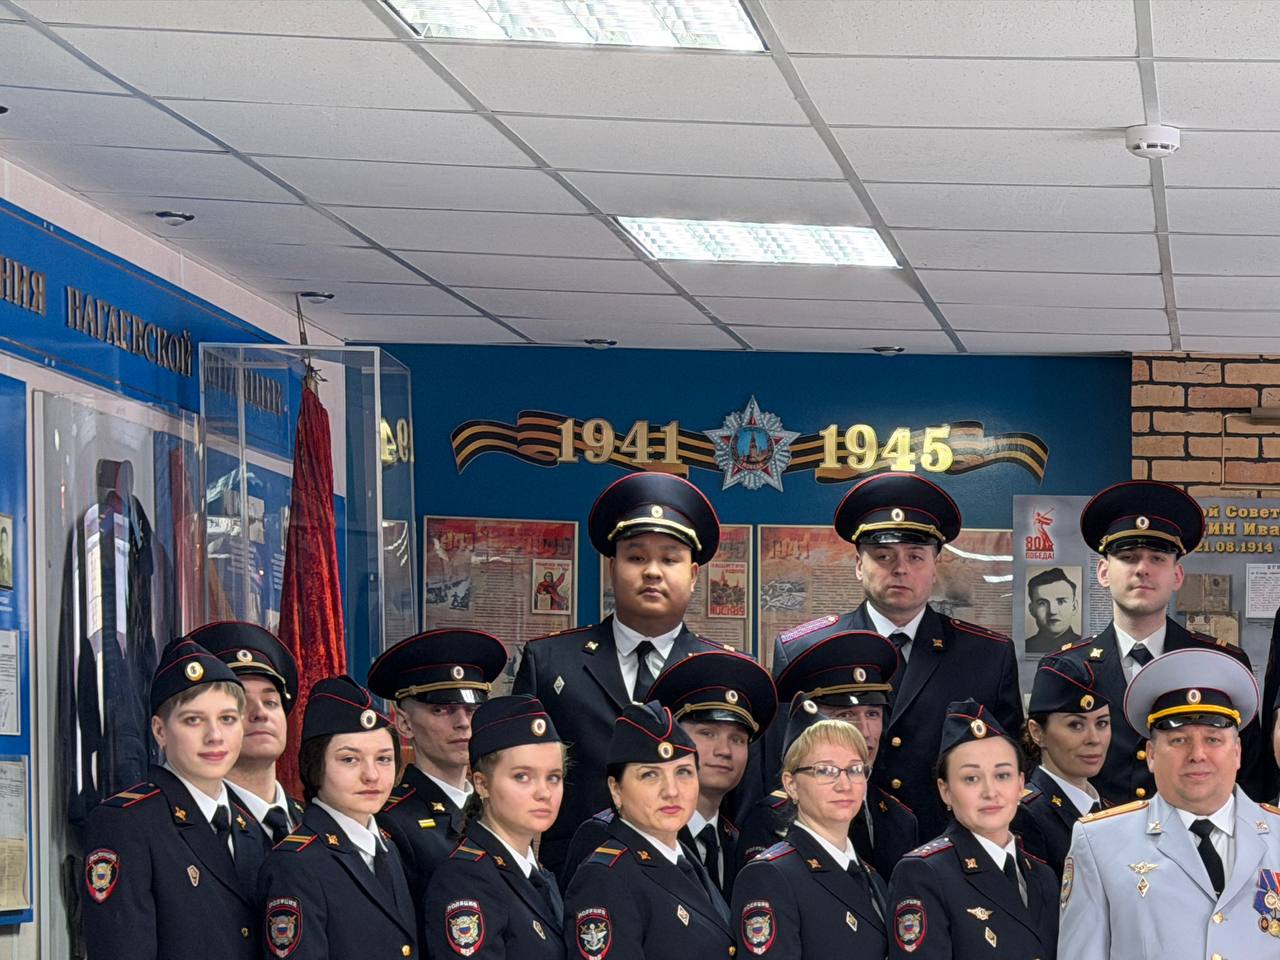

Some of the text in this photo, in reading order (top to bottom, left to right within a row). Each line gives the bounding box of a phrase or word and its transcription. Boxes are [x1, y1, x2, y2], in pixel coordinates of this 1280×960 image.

[66, 286, 192, 377] НАГАЕВСКОЙ
[557, 418, 682, 464] 1941
[819, 423, 954, 472] 1945
[1025, 535, 1041, 550] 80
[1204, 521, 1236, 538] ИН
